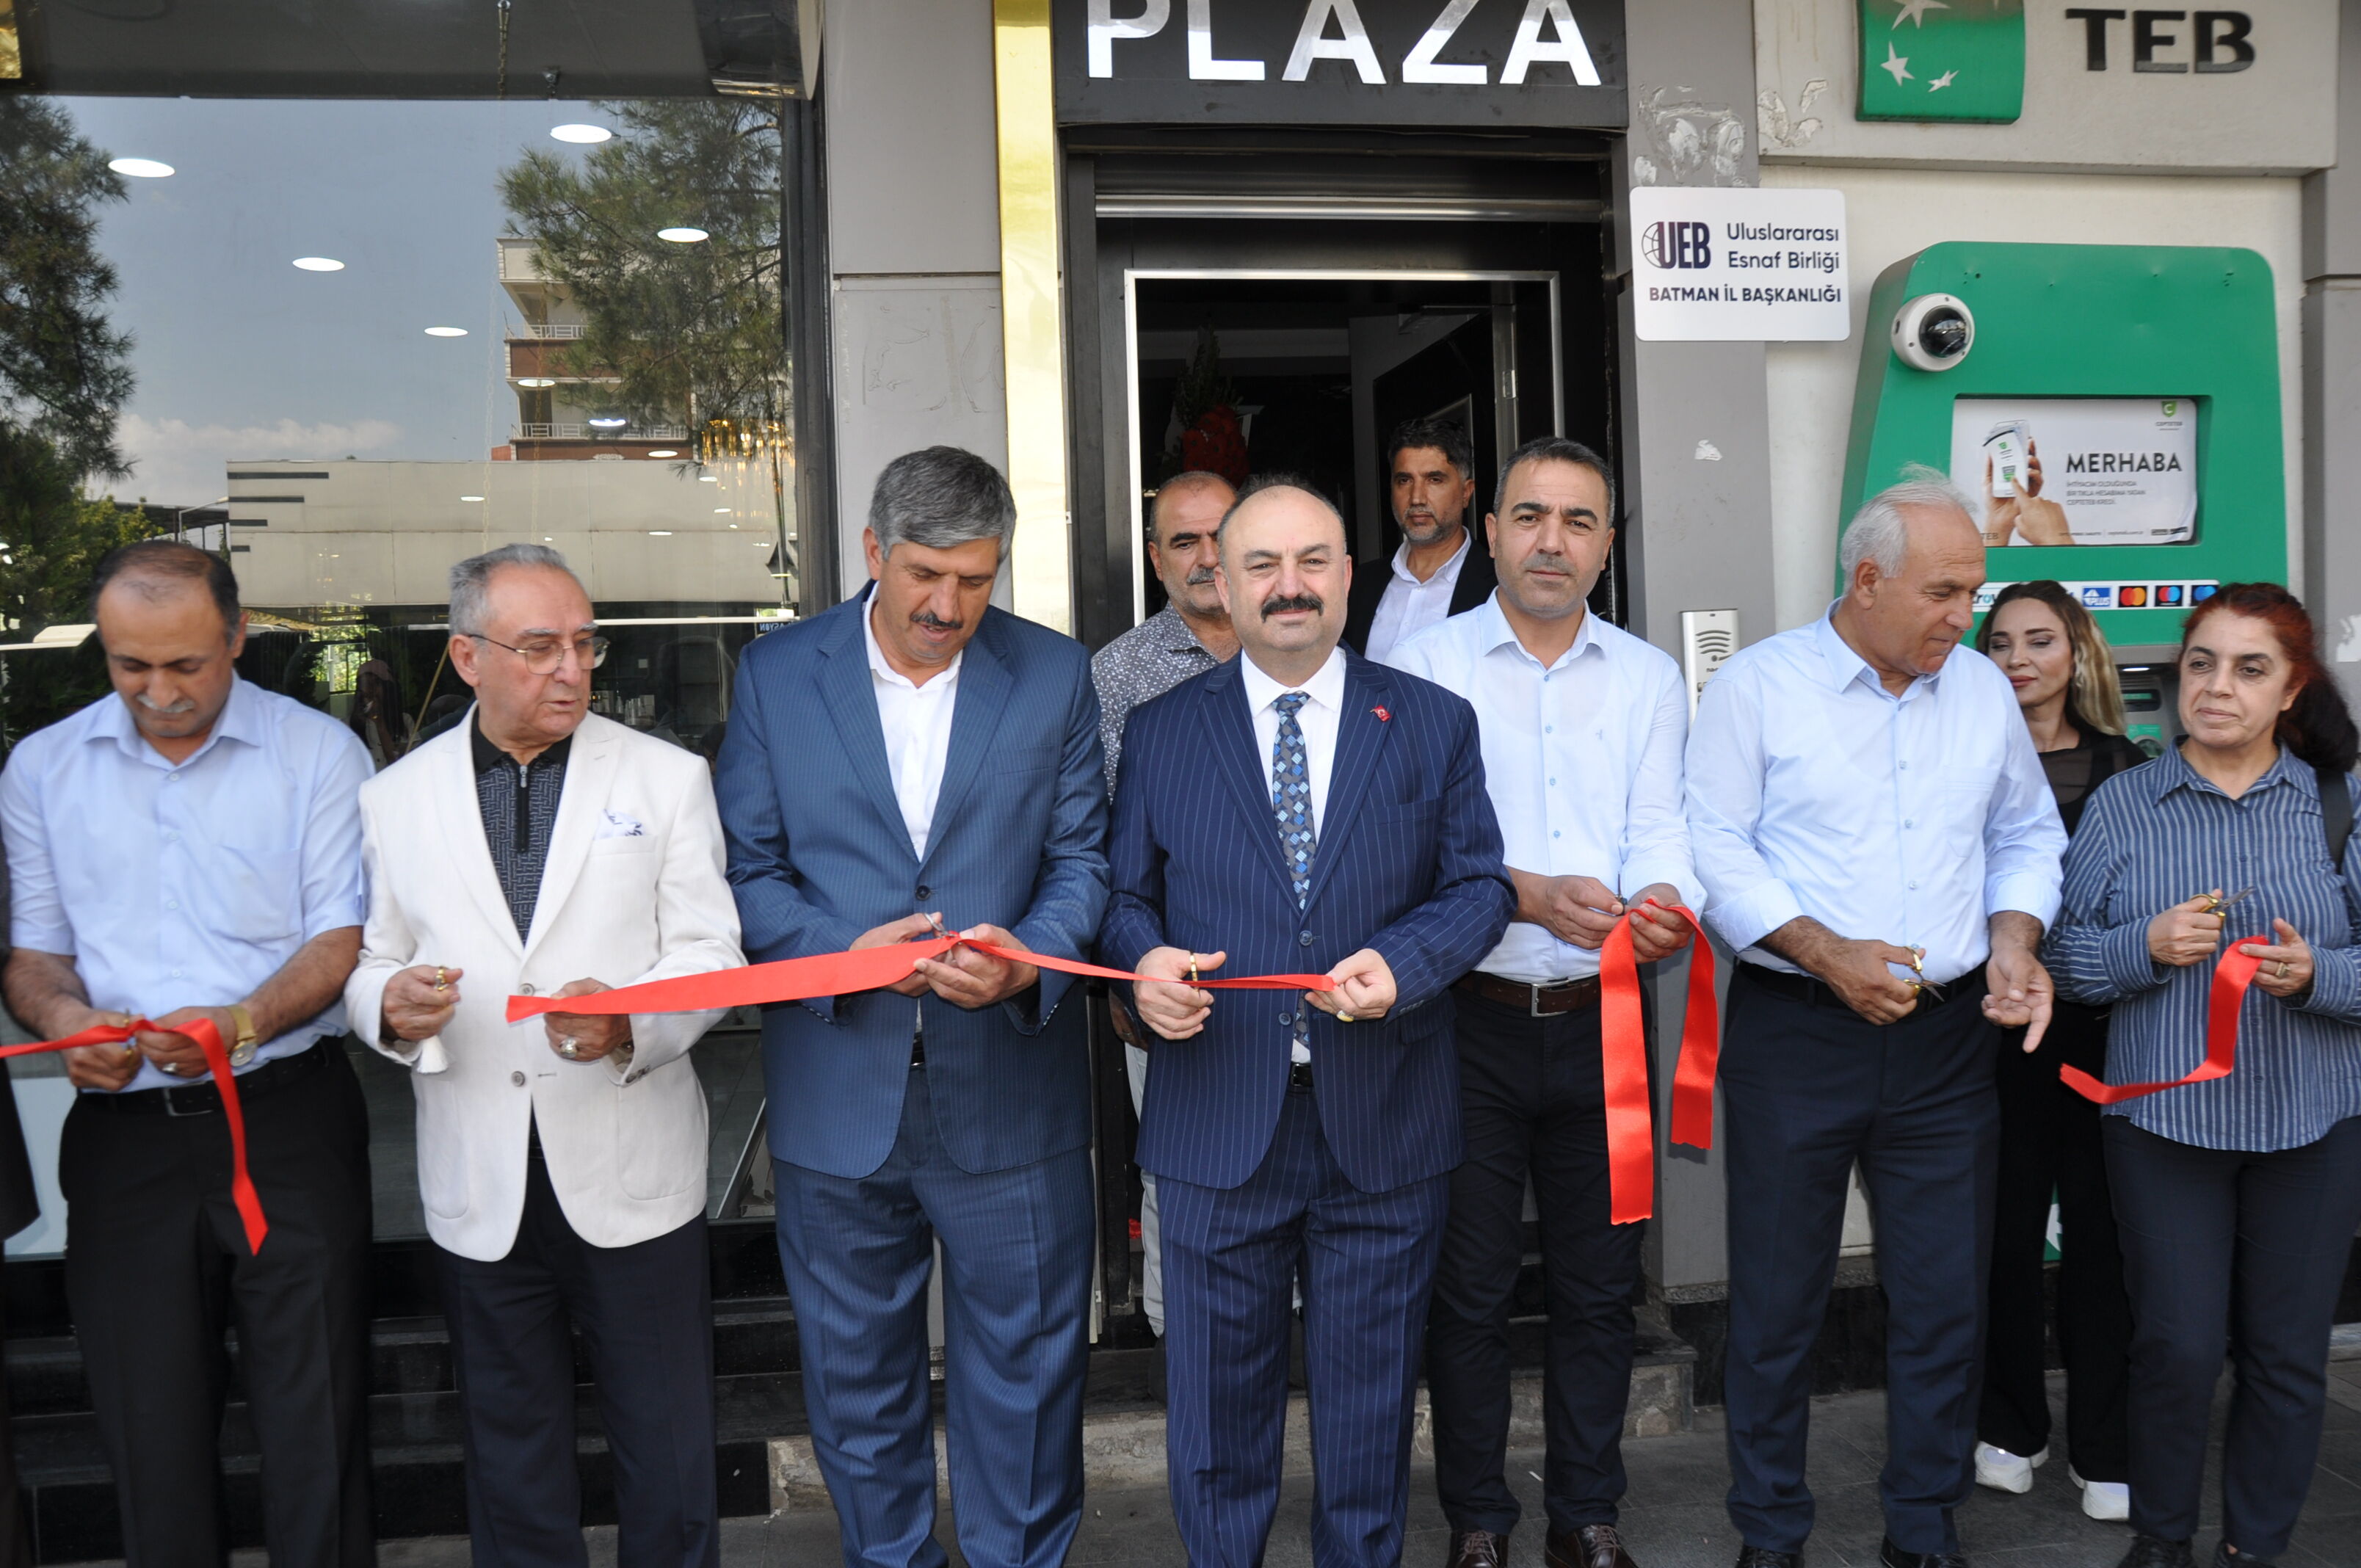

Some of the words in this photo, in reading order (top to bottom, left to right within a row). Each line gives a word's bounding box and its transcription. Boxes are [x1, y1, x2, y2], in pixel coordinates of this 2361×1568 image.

[1087, 0, 1601, 86] PLAZA
[2065, 8, 2256, 73] TEB
[1727, 222, 1839, 242] Uluslararası
[1657, 221, 1711, 269] UEB
[1728, 251, 1782, 269] Esnaf
[1788, 252, 1840, 274] Birliği
[1649, 287, 1719, 302] BATMAN
[1724, 283, 1738, 302] İL
[1742, 285, 1841, 306] BAŞKANLIĞI
[2065, 452, 2183, 473] MERHABA
